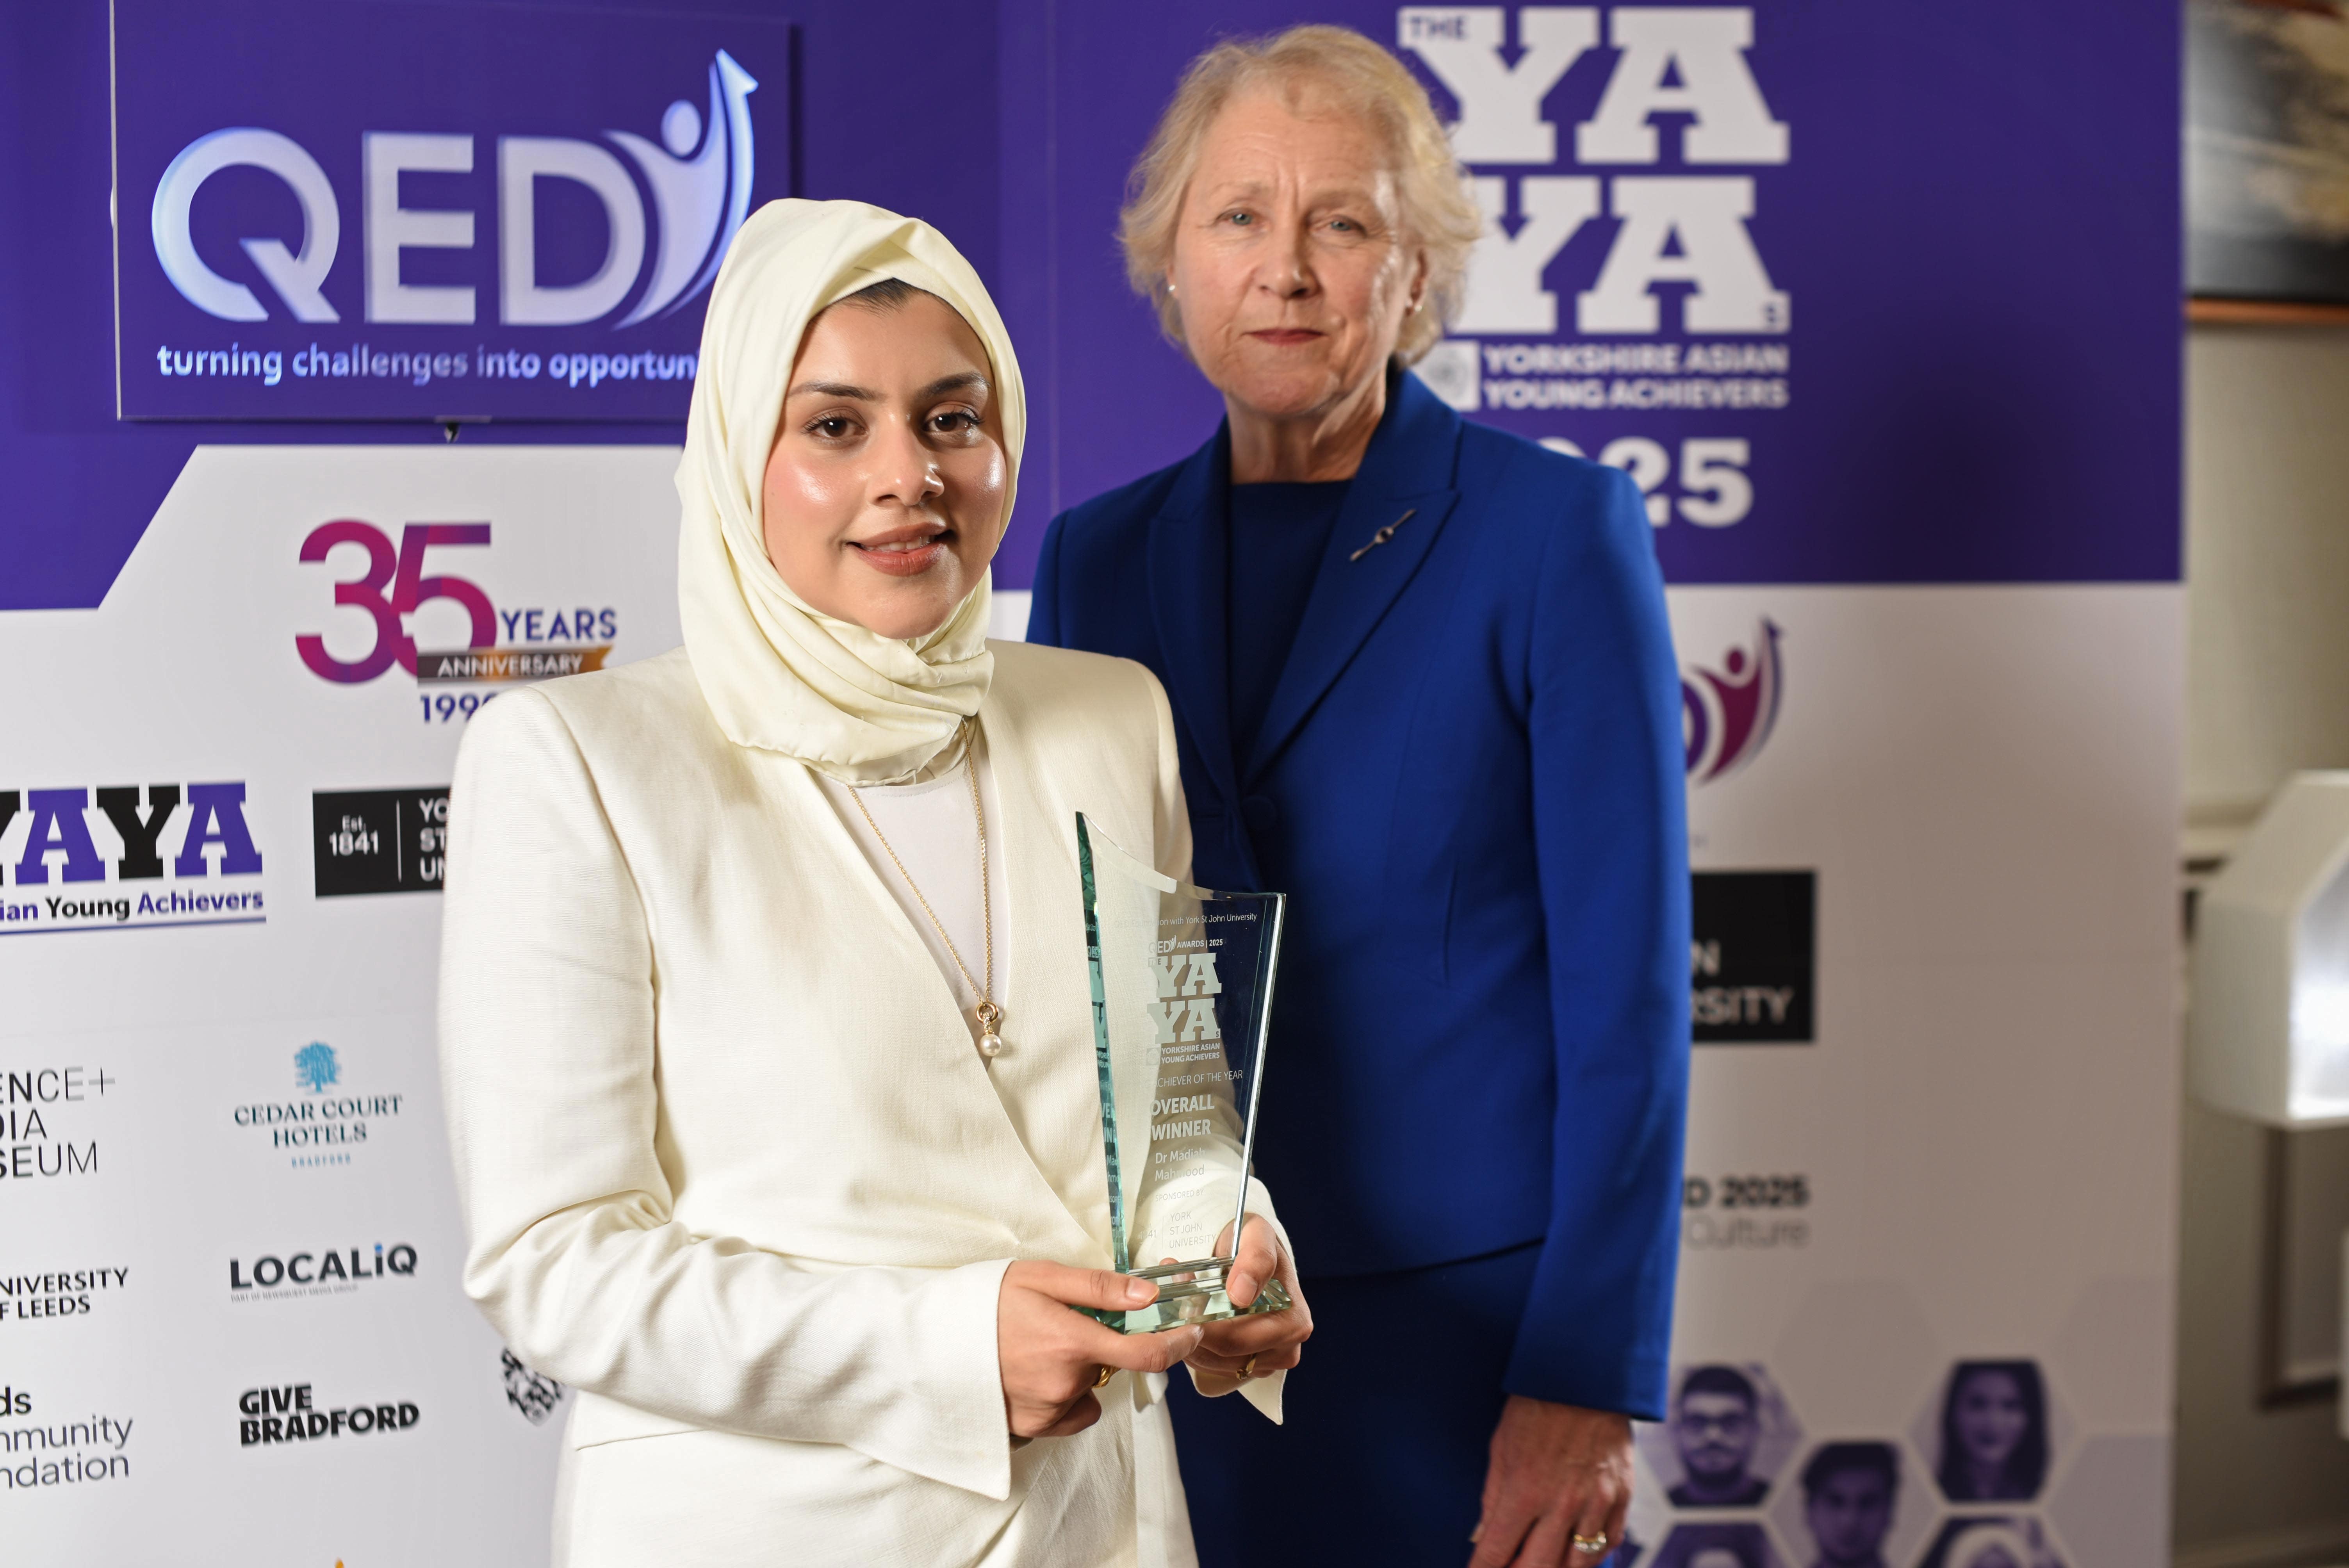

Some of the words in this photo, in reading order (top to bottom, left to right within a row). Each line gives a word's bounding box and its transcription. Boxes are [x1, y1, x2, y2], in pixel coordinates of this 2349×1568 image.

[1399, 7, 1790, 164] YA
[151, 126, 646, 325] QED
[1449, 176, 1791, 334] YA
[157, 344, 282, 386] turning
[293, 343, 468, 386] challenges
[477, 344, 540, 379] into
[549, 347, 700, 388] opportun
[1484, 344, 1682, 374] YORKSHIRE
[1683, 344, 1789, 373] ASIAN
[1484, 379, 1605, 409] YOUNG
[1609, 378, 1789, 409] ACHIEVERS
[1537, 437, 1754, 528] 25
[296, 519, 497, 686] 35
[501, 607, 617, 642] YEARS
[437, 652, 584, 678] ANNIVERSARY
[0, 780, 263, 886] AYA
[329, 830, 379, 857] 1841
[45, 895, 130, 923] Young
[137, 888, 264, 916] Achievers
[1226, 913, 1257, 922] University
[1177, 940, 1204, 948] AWARDS
[1209, 939, 1223, 947] 2025
[1148, 952, 1222, 998] YA
[1147, 998, 1221, 1044] YA
[1161, 1044, 1199, 1055] YORKSHIRE
[1200, 1042, 1220, 1051] ASIAN
[1161, 1055, 1185, 1064] YOUNG
[1185, 1052, 1220, 1062] ACHIEVERS
[0, 1066, 116, 1105] NCE+
[1194, 1074, 1204, 1084] OF
[1206, 1072, 1222, 1083] THE
[1224, 1069, 1243, 1081] YEAR
[234, 1101, 315, 1127] CEDAR
[321, 1094, 403, 1121] COURT
[1150, 1094, 1215, 1116] OVERALL
[273, 1121, 367, 1149] HOTELS
[1151, 1119, 1211, 1141] WINNER
[1155, 1152, 1167, 1164] Dr
[1155, 1164, 1205, 1181] Mahood
[1155, 1190, 1194, 1202] SPONSORED
[1169, 1226, 1179, 1236] ST
[1181, 1223, 1202, 1234] JOHN
[1170, 1211, 1192, 1222] YORK
[1169, 1233, 1216, 1249] UNIVERSITY
[18, 1293, 91, 1320] LEEDS
[239, 1381, 312, 1416] GIVE
[239, 1399, 420, 1448] BRADFORD
